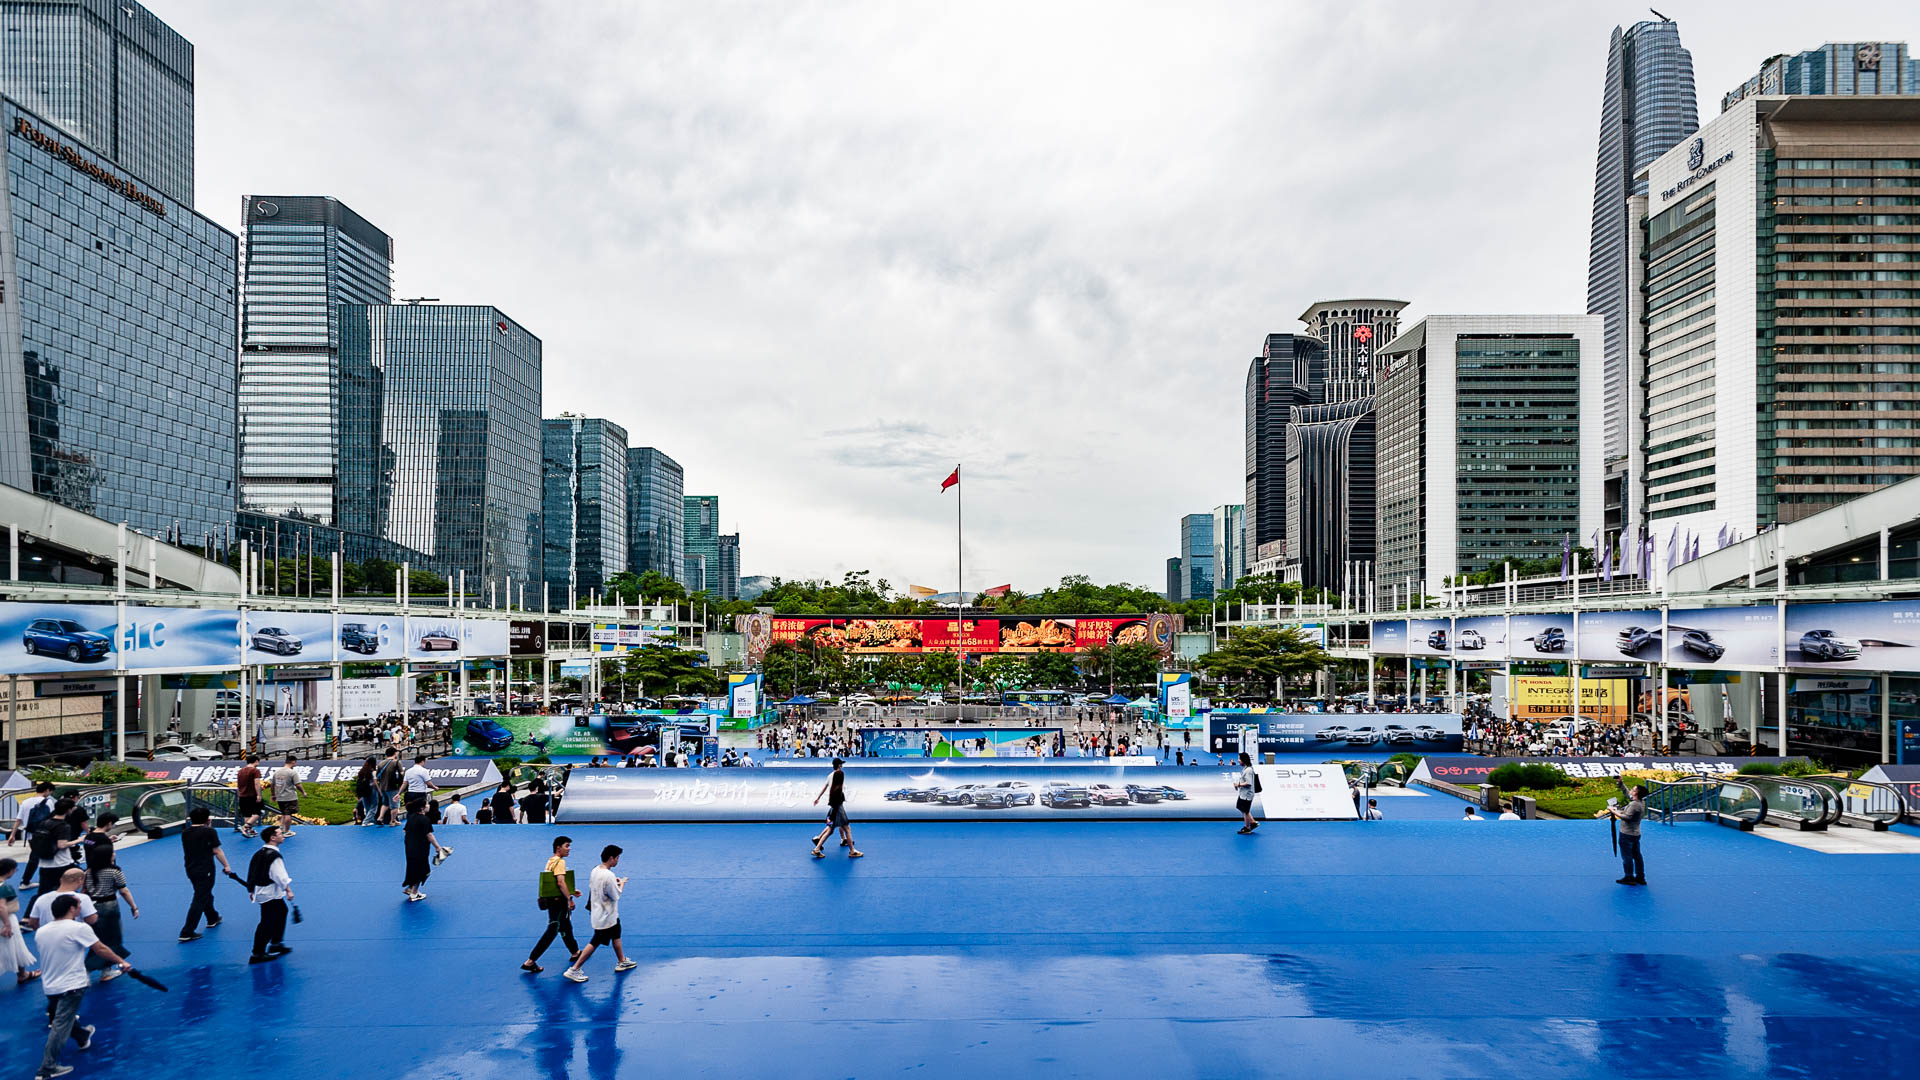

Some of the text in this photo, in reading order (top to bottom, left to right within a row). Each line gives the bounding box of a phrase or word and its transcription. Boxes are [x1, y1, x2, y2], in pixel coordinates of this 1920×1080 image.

[16, 117, 167, 216] FOUR SEASONS HOTEL
[1661, 150, 1734, 201] THE RITZ-CARLTON
[1357, 345, 1369, 377] 大中华
[114, 620, 167, 652] GLC
[377, 621, 391, 647] G
[408, 623, 473, 643] MAYBAH
[1275, 769, 1323, 779] BYD
